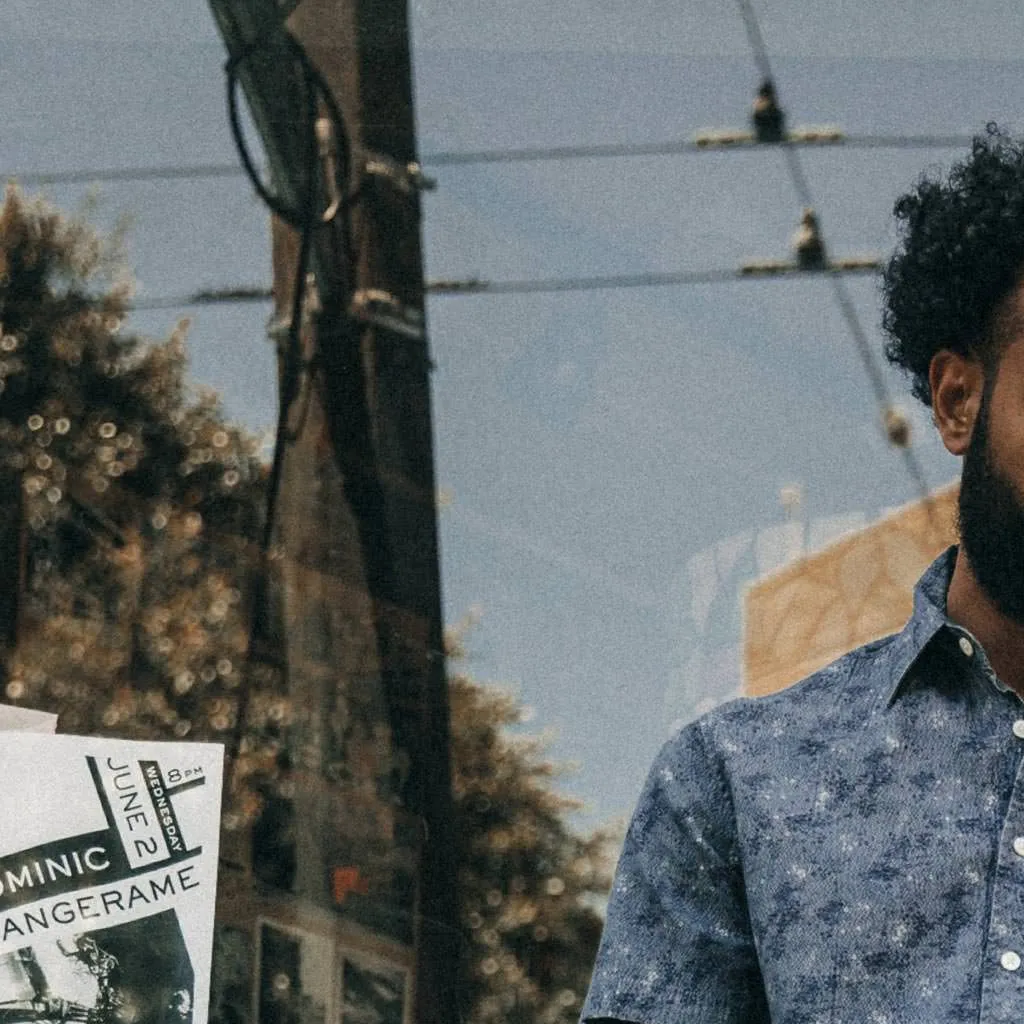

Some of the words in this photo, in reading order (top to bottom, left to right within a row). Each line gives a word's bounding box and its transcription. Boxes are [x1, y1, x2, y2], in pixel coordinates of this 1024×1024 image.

[107, 757, 149, 831] JUNE
[134, 836, 158, 858] 2
[145, 765, 183, 852] WEDNESDAY
[0, 846, 111, 896] MINIC
[3, 865, 200, 941] ANGERAME
